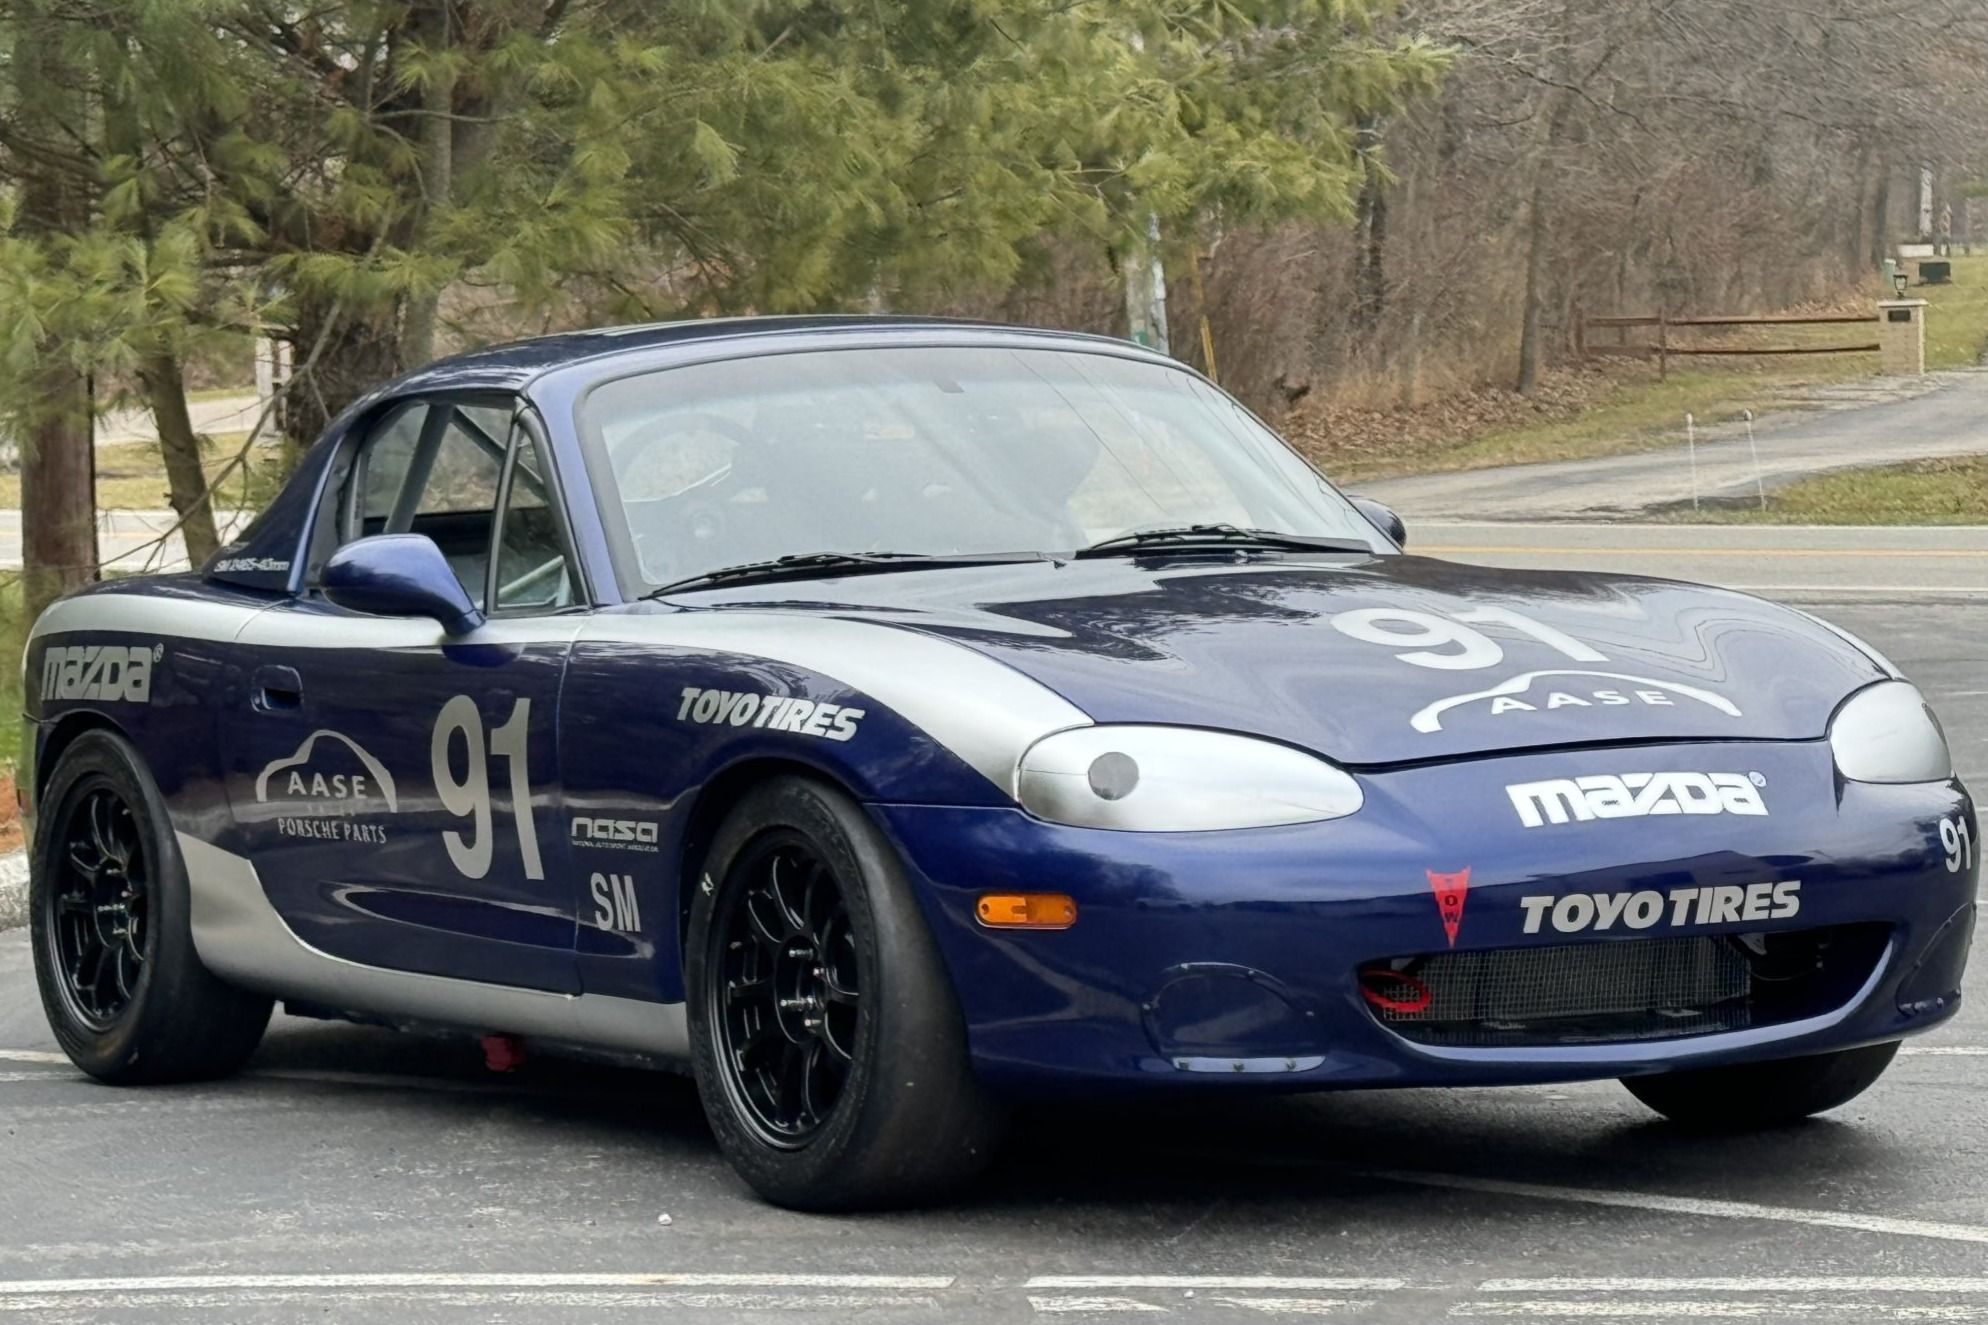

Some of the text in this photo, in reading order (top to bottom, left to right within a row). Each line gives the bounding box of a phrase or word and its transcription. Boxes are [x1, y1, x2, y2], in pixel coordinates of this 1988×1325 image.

[1330, 606, 1610, 670] 91
[677, 687, 866, 742] TOYO TIRES
[1491, 689, 1674, 715] AASE
[287, 771, 368, 799] AASE
[431, 694, 545, 880] 91
[278, 817, 387, 844] PORSCHE PARTS
[1939, 815, 1972, 873] 91
[590, 872, 641, 932] SM
[1520, 880, 1801, 934] TOYO TIRES
